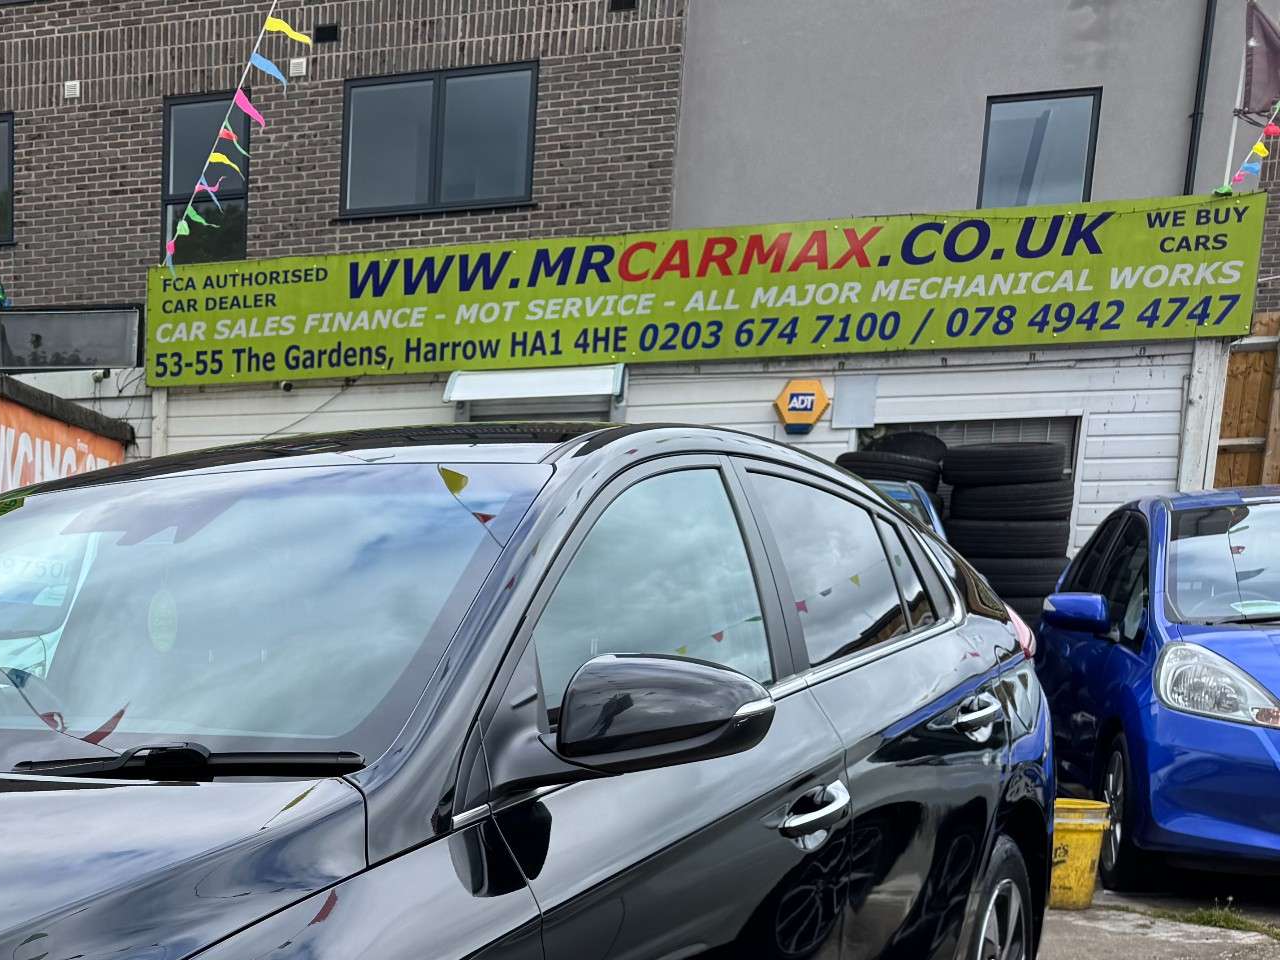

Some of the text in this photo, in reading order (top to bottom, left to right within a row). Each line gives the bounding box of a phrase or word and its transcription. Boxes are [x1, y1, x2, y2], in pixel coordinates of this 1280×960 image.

[1146, 205, 1250, 229] WE BUY
[348, 211, 1117, 298] WWW.MRCARMAX.CO.UK
[1159, 233, 1228, 253] CARS
[162, 267, 328, 292] FCA AUTHORISED
[156, 322, 207, 344] CAR
[214, 315, 298, 340] SALES
[303, 306, 427, 335] FINANCE
[455, 300, 519, 325] MOT
[525, 293, 656, 321] SERVICE
[685, 288, 740, 312] ALL
[750, 281, 862, 311] MAJOR
[871, 269, 1094, 302] MECHANICAL
[1108, 260, 1245, 290] WORKS
[162, 293, 277, 314] CAR DEALER
[155, 349, 224, 378] 53-55
[231, 347, 275, 373] The
[284, 340, 394, 372] Gardens,
[405, 335, 500, 364] Harrow
[510, 330, 562, 357] HA1
[573, 326, 629, 354] 4HE
[638, 320, 722, 352] 0203
[734, 317, 799, 348] 674
[815, 310, 901, 344] 7100
[945, 303, 1016, 337] 078
[1027, 299, 1125, 334] 4942
[1136, 294, 1241, 328] 4747
[788, 396, 815, 409] ADT
